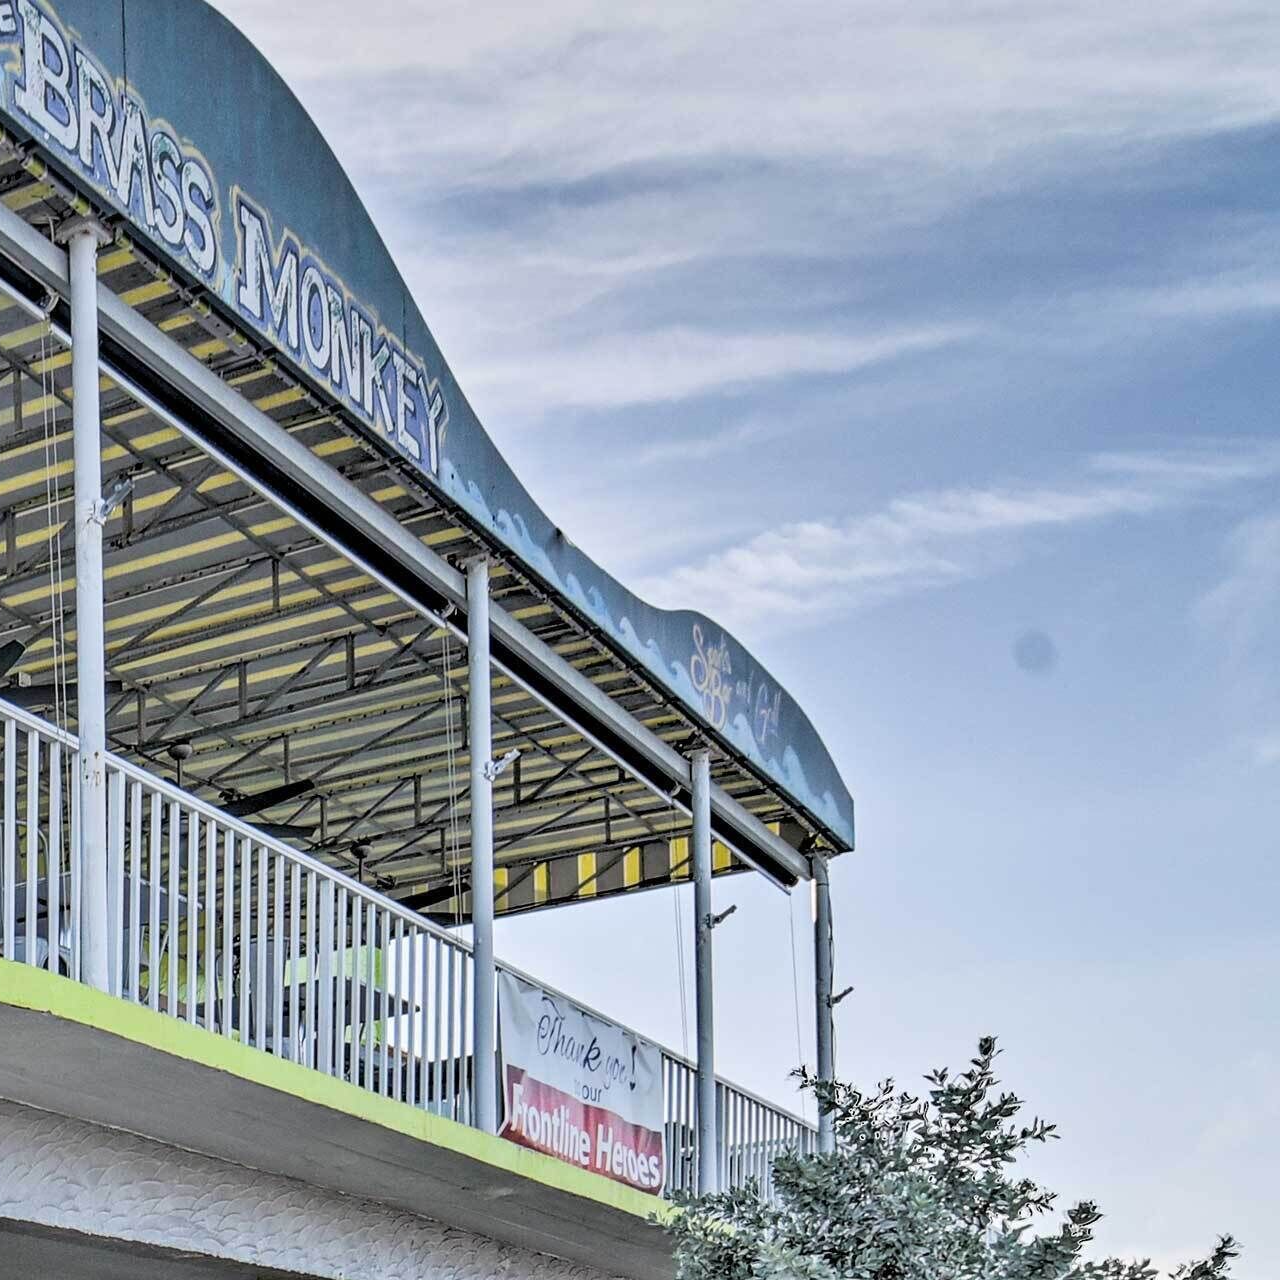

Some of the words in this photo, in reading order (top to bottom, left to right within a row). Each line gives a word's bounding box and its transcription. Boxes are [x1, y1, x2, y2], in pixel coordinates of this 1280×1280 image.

[15, 0, 217, 273] BRASS
[239, 204, 443, 477] MONKEY
[512, 1082, 591, 1166] Frontline
[595, 1123, 660, 1188] Heroes
[582, 1084, 602, 1103] our
